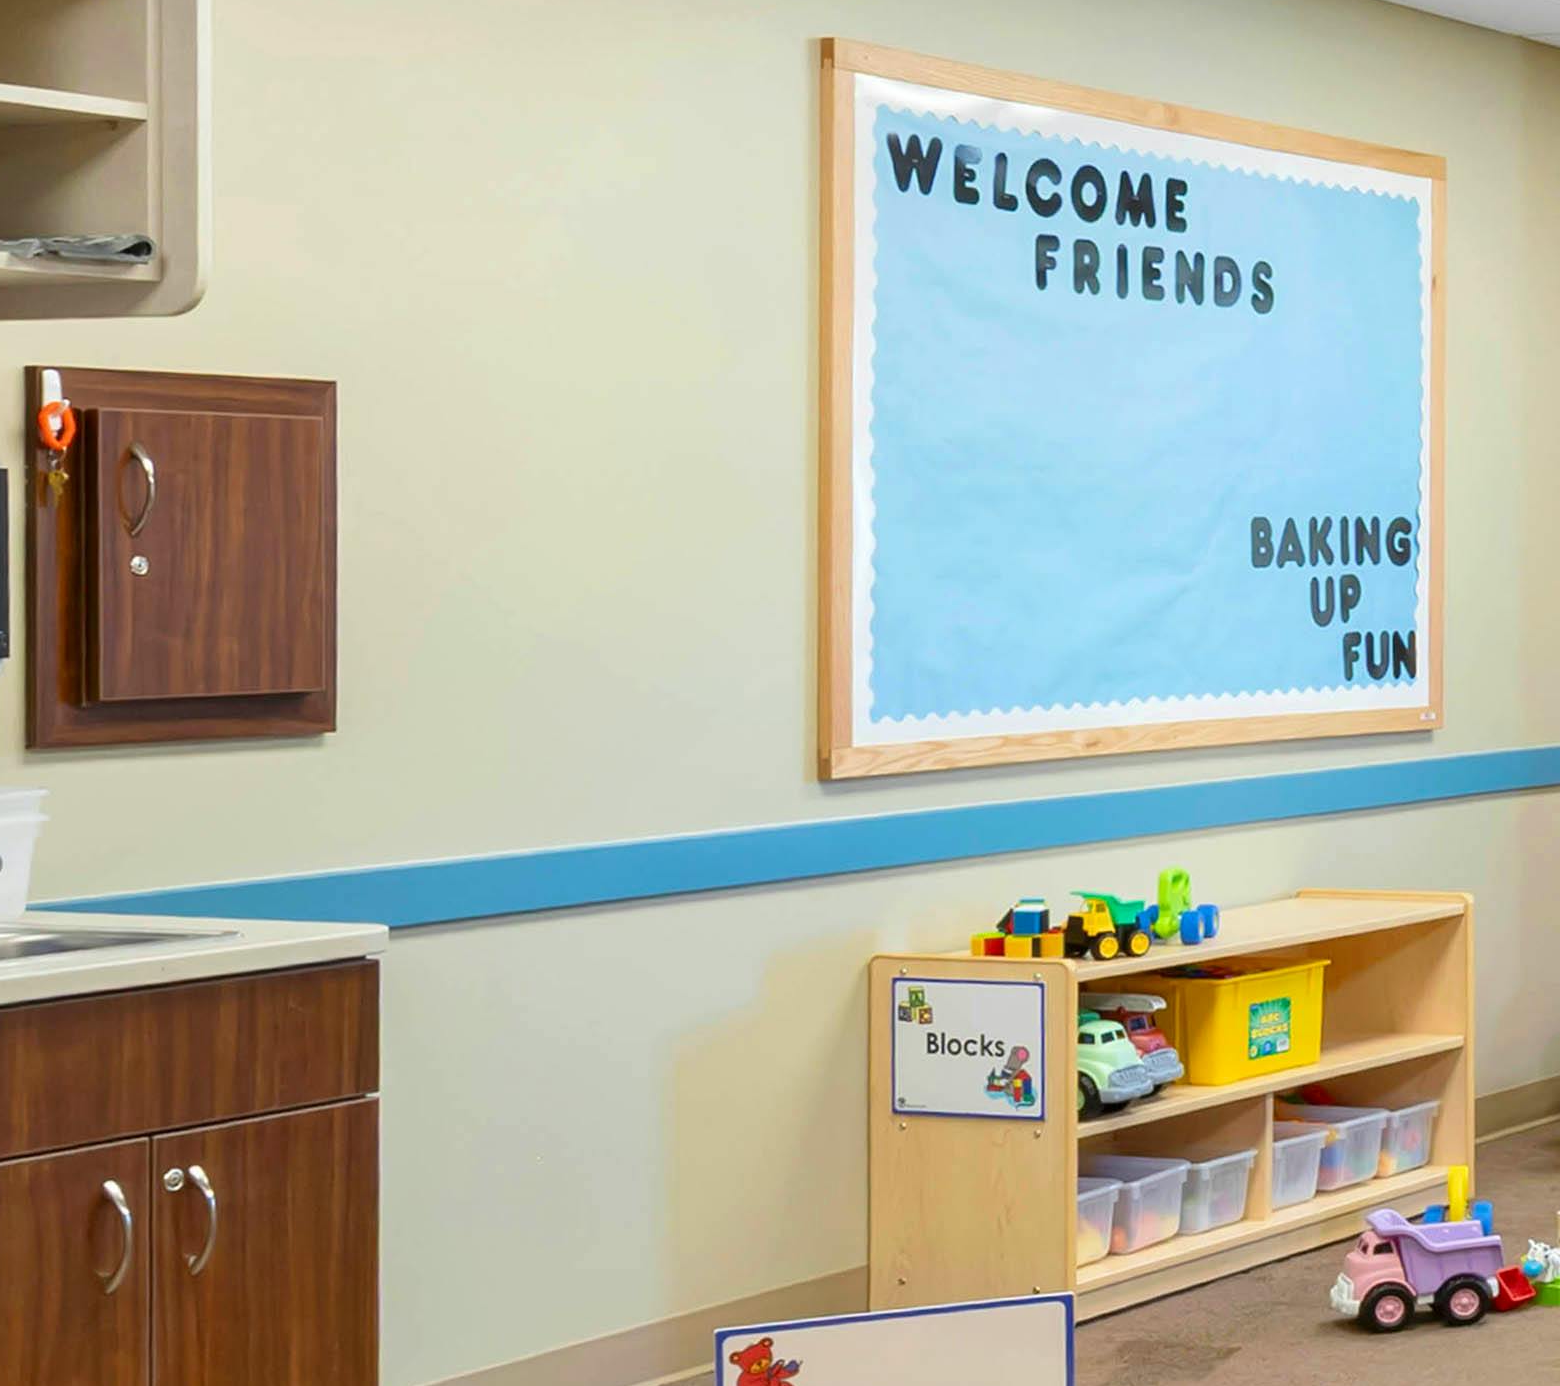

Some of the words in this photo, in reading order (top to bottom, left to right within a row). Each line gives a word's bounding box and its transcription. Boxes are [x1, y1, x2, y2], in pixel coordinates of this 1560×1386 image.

[887, 132, 1189, 234] WELCOME
[1035, 233, 1276, 315] FRIENDS
[1250, 516, 1413, 569] BAKING
[1311, 573, 1362, 628] UP
[1343, 630, 1417, 682] FUN
[927, 1032, 1005, 1057] Blocks
